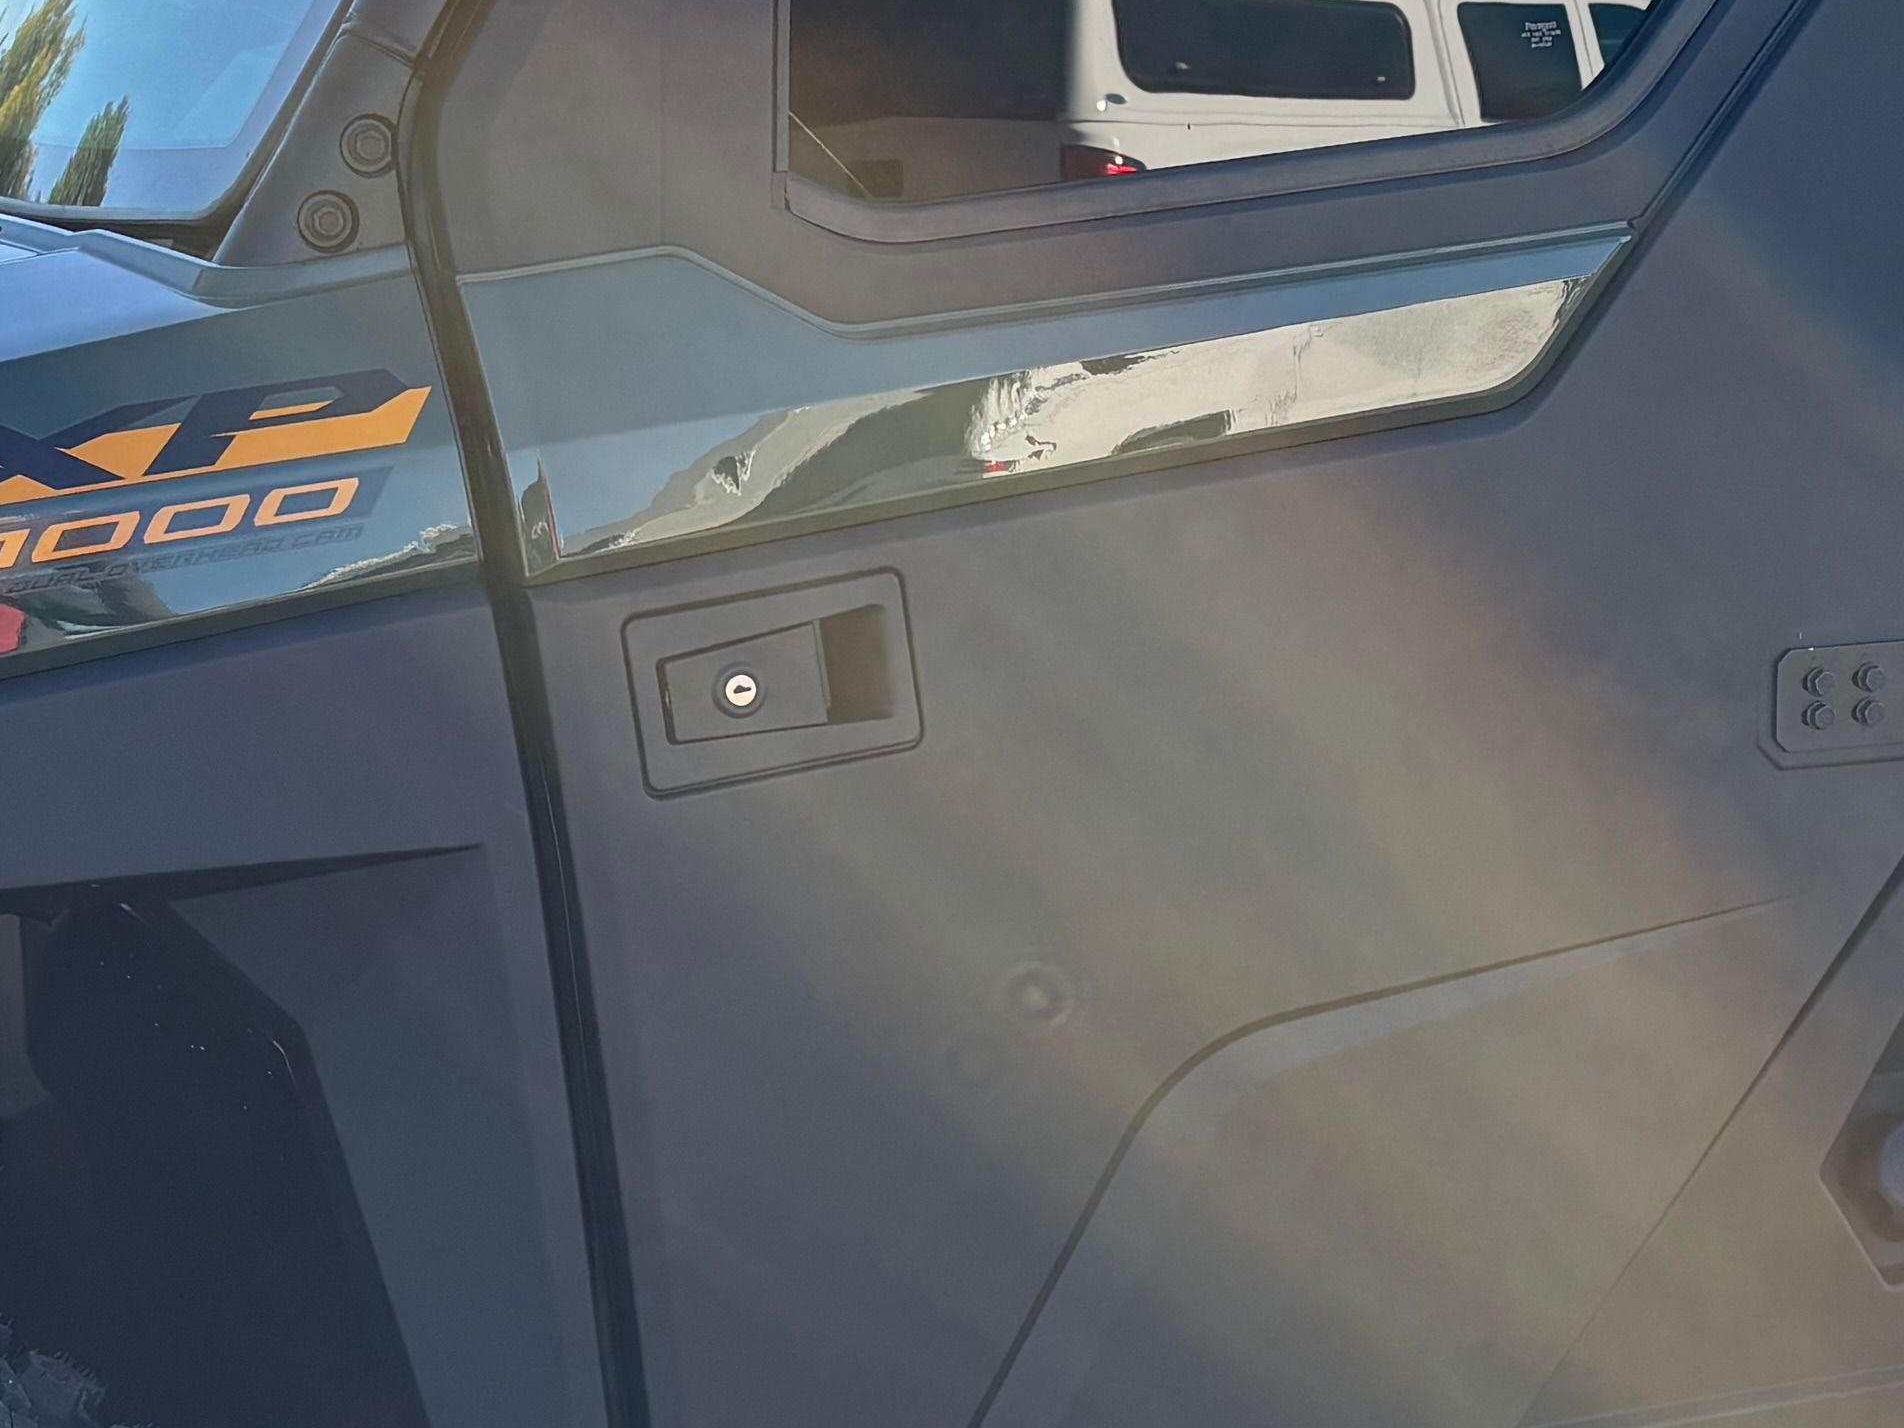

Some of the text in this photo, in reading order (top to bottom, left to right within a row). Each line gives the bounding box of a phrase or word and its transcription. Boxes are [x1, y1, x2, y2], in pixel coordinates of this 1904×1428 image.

[8, 525, 365, 593] DUAL OVERHEAD CAM
